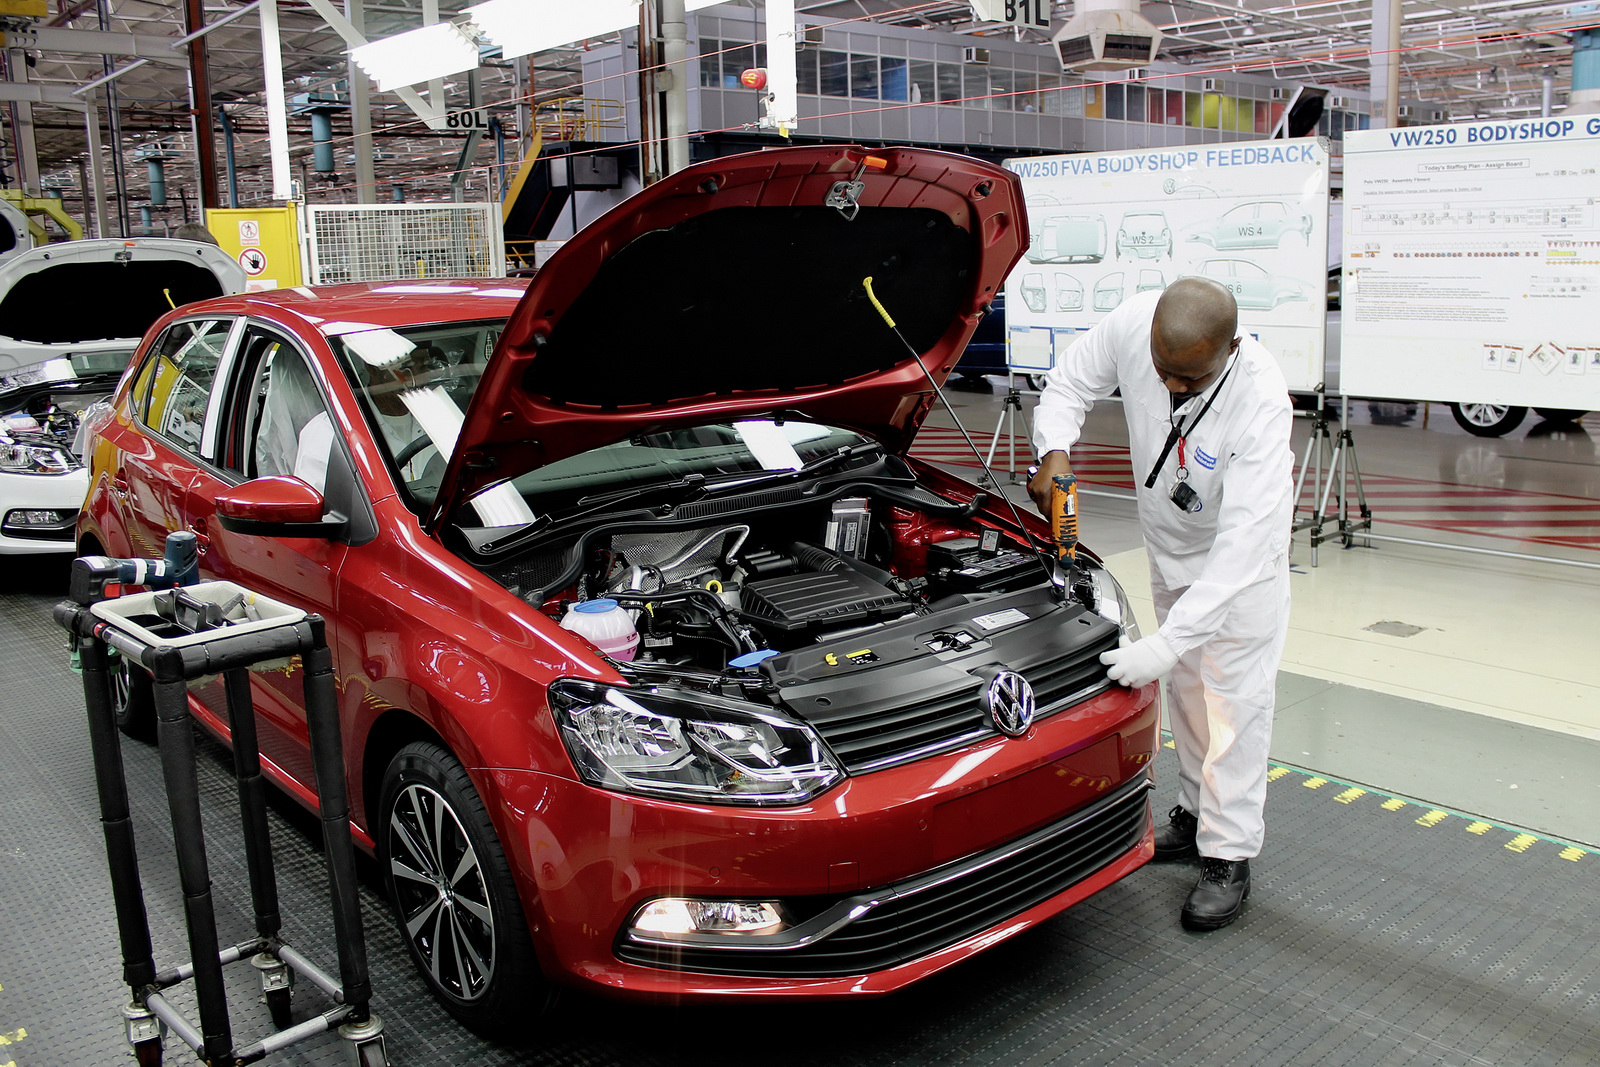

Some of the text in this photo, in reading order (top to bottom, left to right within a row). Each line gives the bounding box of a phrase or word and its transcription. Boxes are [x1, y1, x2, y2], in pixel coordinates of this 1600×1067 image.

[447, 111, 487, 128] 80L
[1390, 128, 1457, 147] VW250
[1467, 120, 1574, 143] BODYSHOP
[1061, 159, 1093, 176] FVA
[1097, 152, 1198, 174] BODYSHOP
[1207, 144, 1315, 167] FEEDBACK
[1238, 226, 1262, 236] WS 4
[1035, 234, 1040, 243] 7
[1132, 235, 1154, 244] WS 2
[1236, 284, 1242, 293] 6
